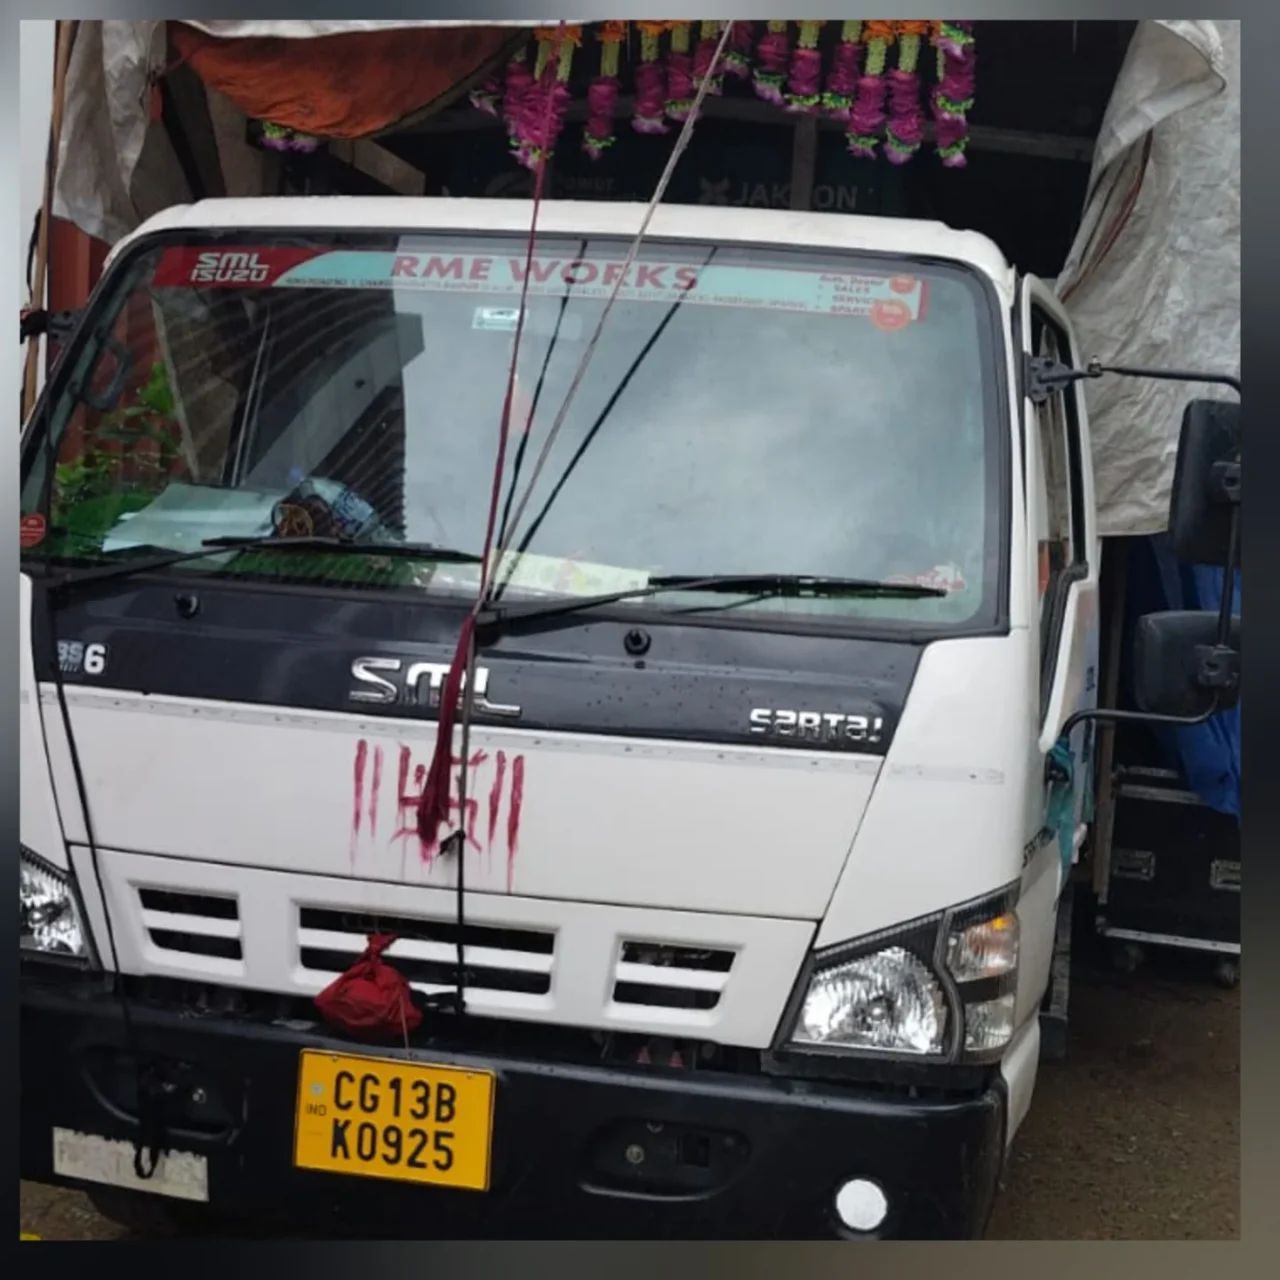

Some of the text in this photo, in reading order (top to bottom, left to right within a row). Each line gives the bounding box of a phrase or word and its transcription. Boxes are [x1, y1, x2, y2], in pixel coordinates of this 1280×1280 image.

[732, 181, 859, 210] JAKON
[190, 268, 269, 282] ISUZU
[196, 252, 271, 269] SML
[391, 255, 698, 291] RME WORKS
[348, 656, 522, 716] SML
[306, 1103, 327, 1117] IND
[334, 1070, 457, 1124] CG13B
[330, 1118, 455, 1172] K0925
